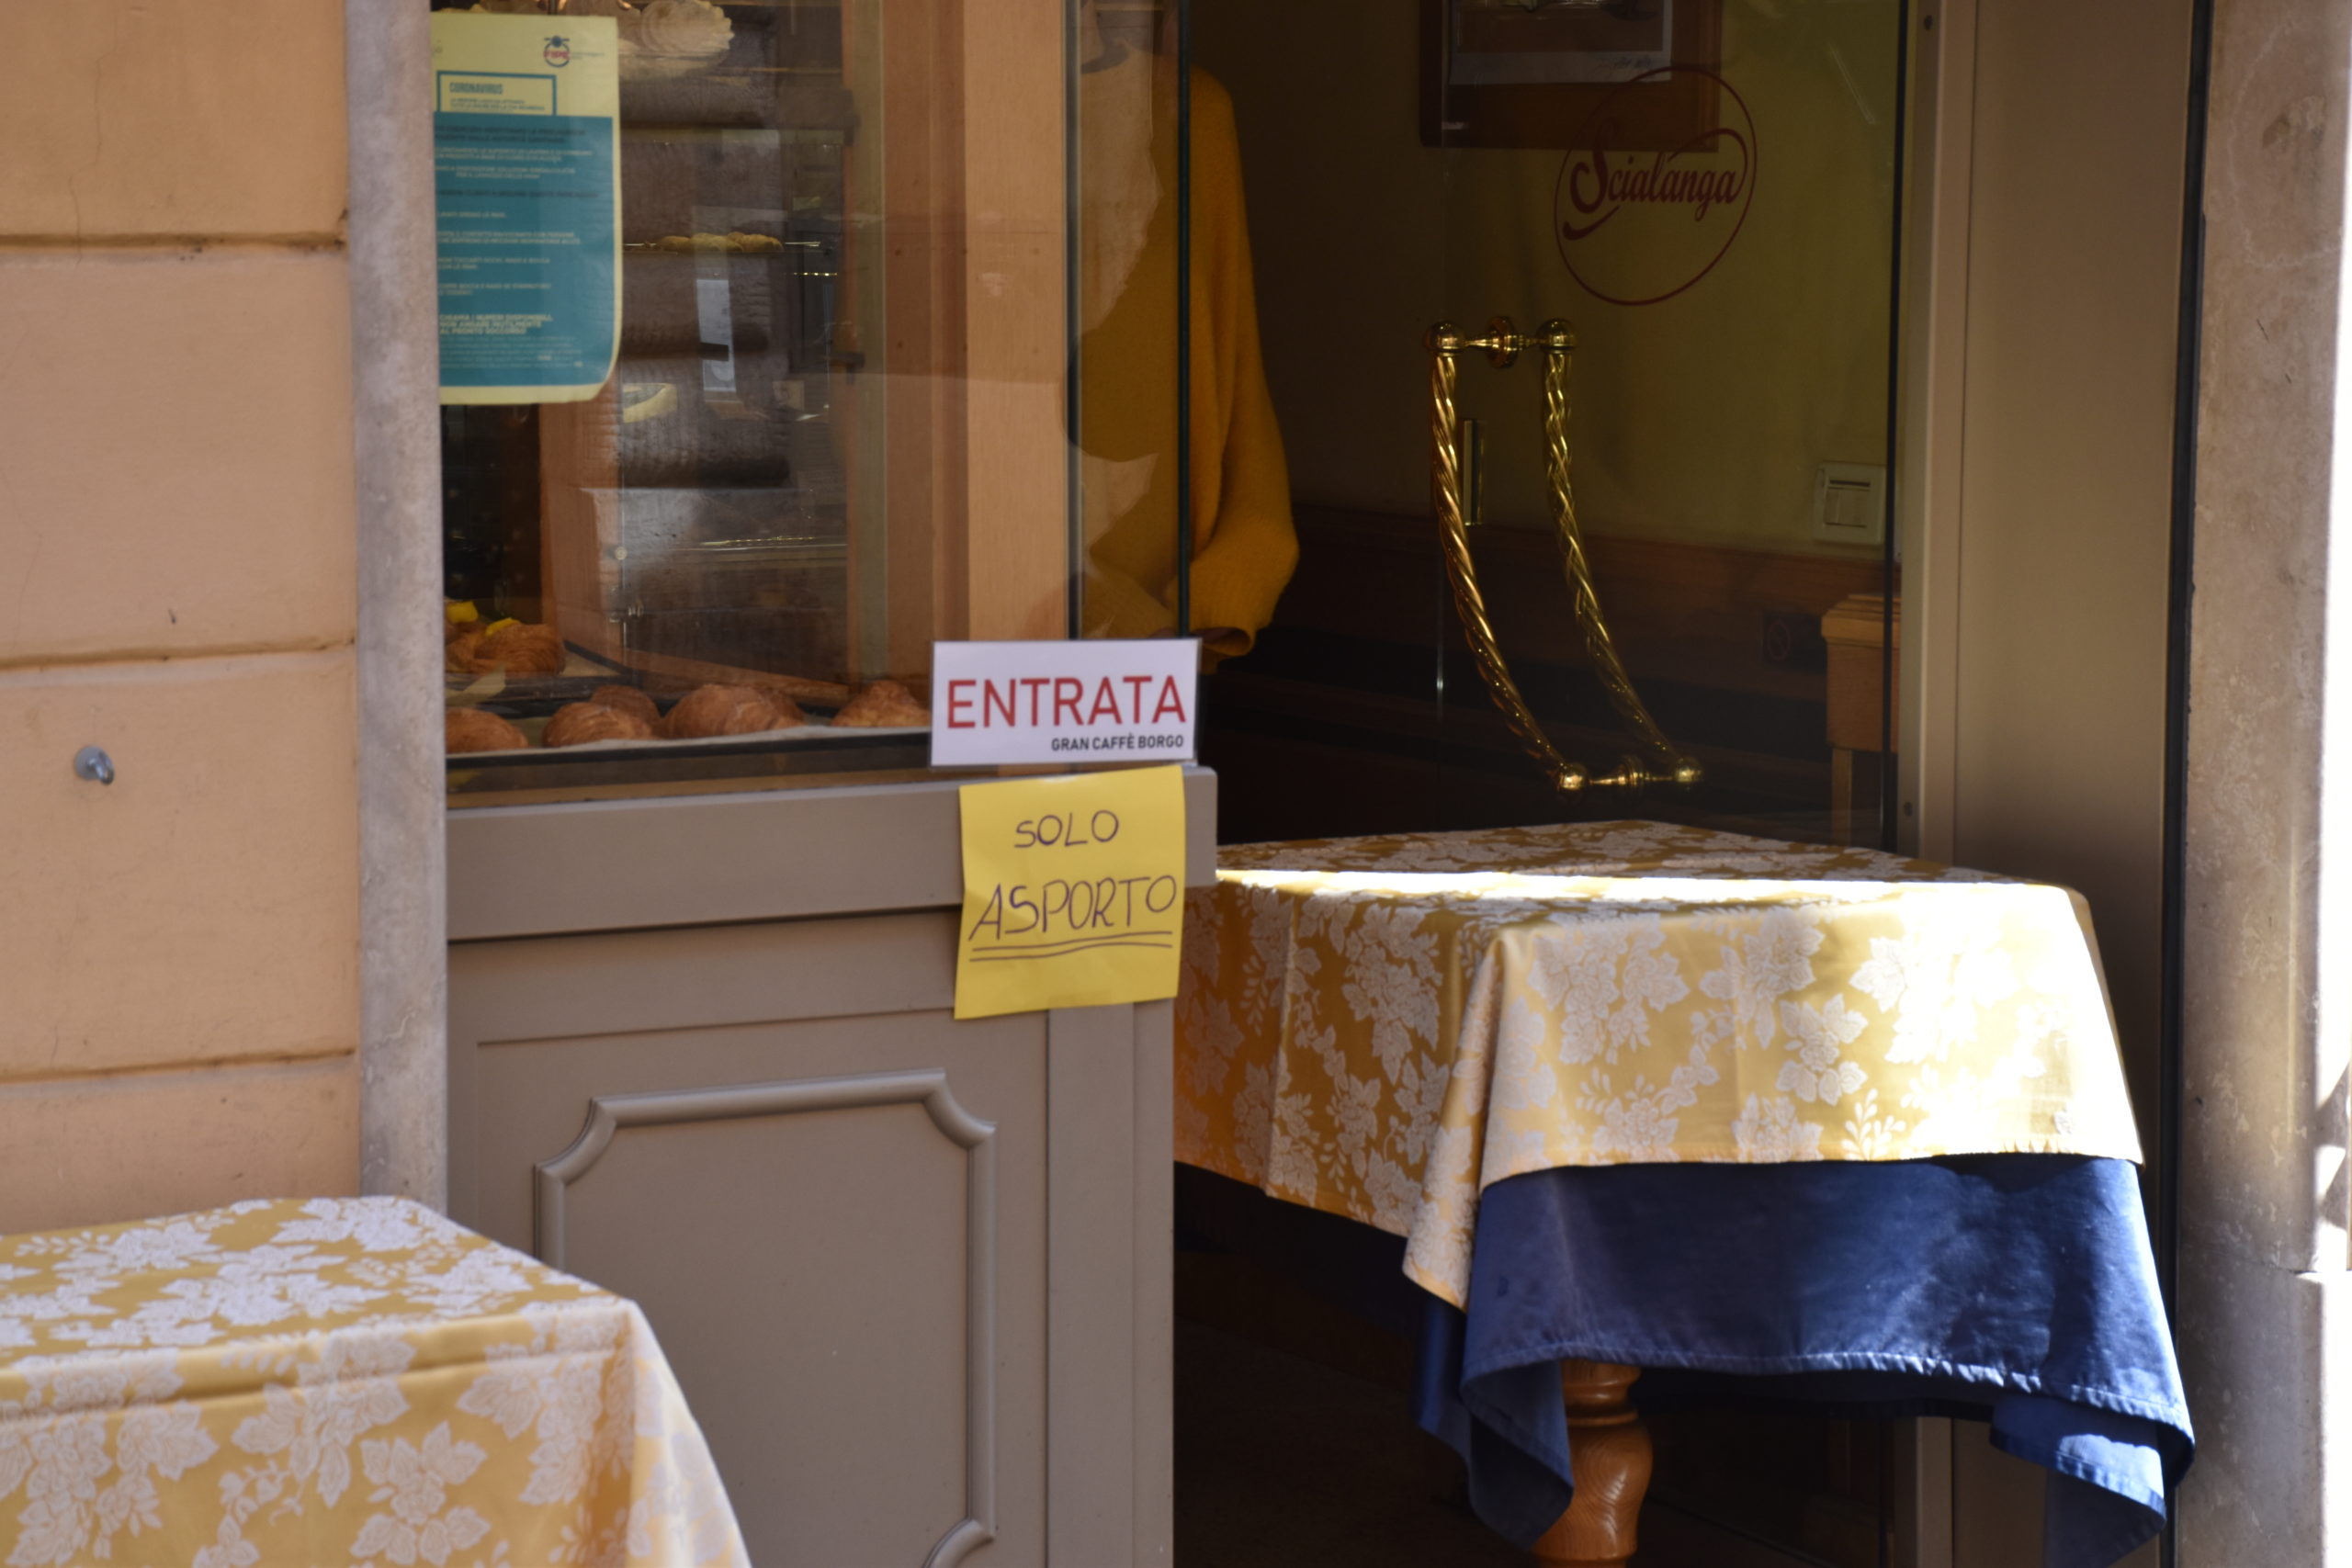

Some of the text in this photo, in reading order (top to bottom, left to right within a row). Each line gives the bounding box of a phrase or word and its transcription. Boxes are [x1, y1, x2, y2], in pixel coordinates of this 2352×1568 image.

[1563, 120, 1747, 241] Scialanga
[947, 675, 1186, 728] ENTRATA
[1051, 732, 1184, 751] GRAN CAFFÈ BORGO
[1014, 810, 1119, 848] SOLO
[968, 874, 1177, 942] ASPORTO
